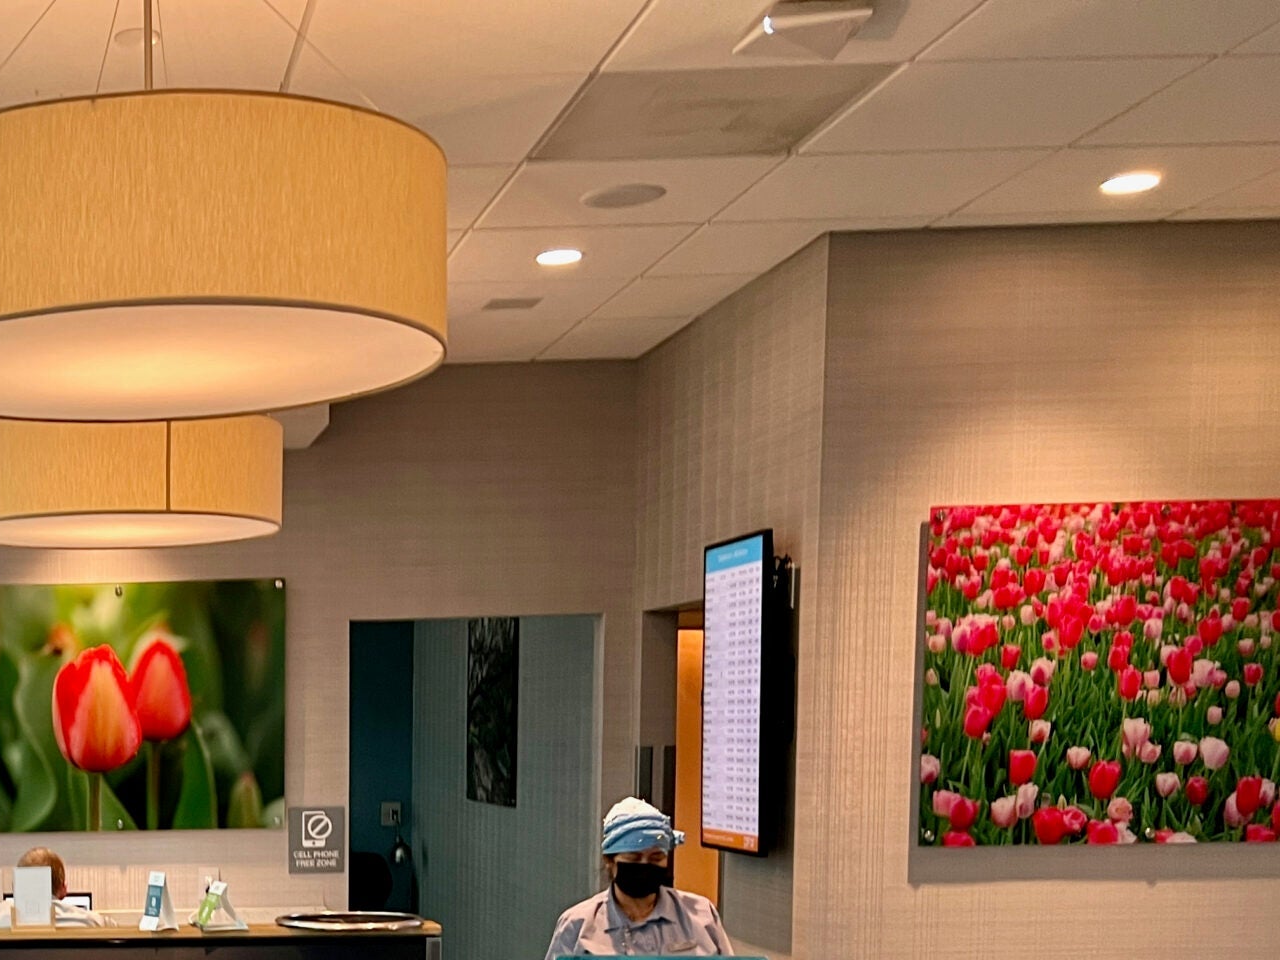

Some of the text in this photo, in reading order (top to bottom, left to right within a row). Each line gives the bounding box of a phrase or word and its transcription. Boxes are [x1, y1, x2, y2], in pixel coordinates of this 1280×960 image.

[293, 850, 340, 859] CELL PHONE
[295, 859, 337, 868] FREE ZONE
